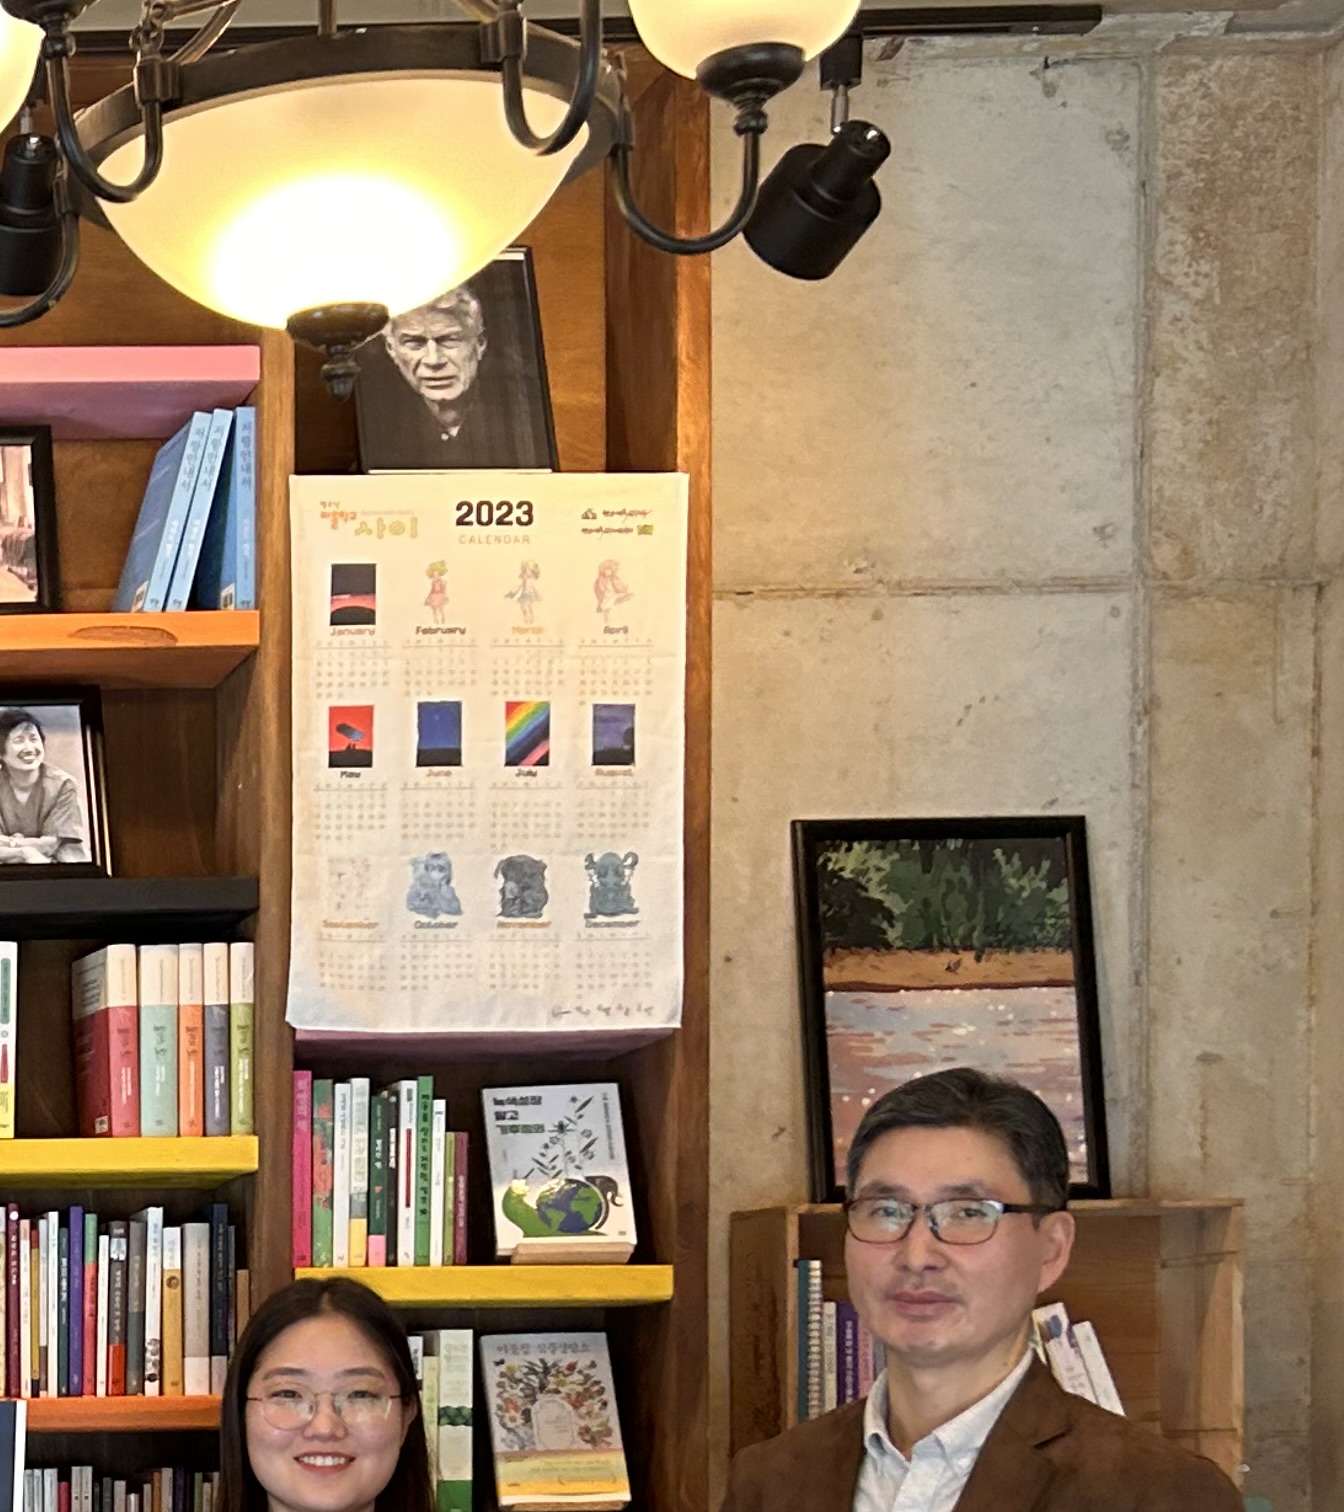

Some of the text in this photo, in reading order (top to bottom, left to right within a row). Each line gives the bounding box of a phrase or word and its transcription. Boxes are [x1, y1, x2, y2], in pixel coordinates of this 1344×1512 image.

[455, 500, 535, 527] 2023
[458, 535, 531, 545] CALENDAR
[329, 626, 376, 637] January
[415, 625, 467, 636] February
[414, 920, 458, 930] October
[584, 919, 640, 929] December
